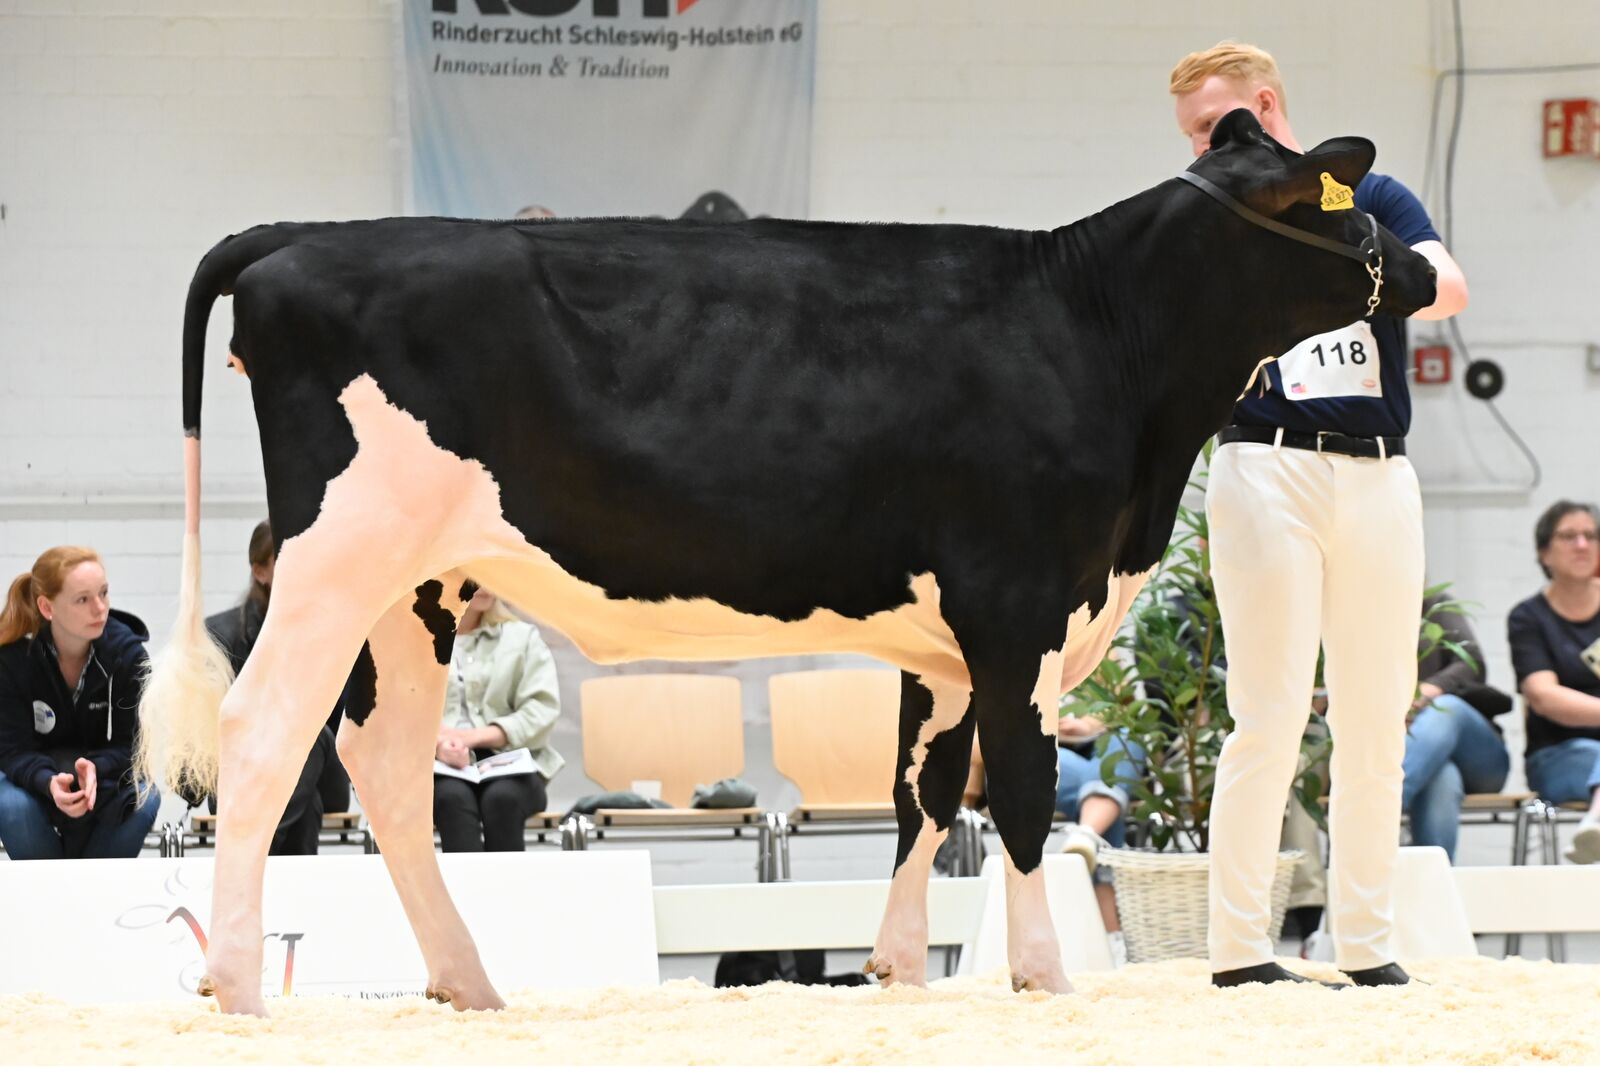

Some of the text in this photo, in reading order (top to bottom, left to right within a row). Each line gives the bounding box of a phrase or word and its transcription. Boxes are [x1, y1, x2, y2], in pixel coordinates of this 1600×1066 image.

[431, 20, 563, 44] Rinderzucht
[568, 23, 775, 52] Schleswig-Holstein
[433, 53, 670, 79] Innovation & Tradition
[1310, 340, 1367, 367] 118
